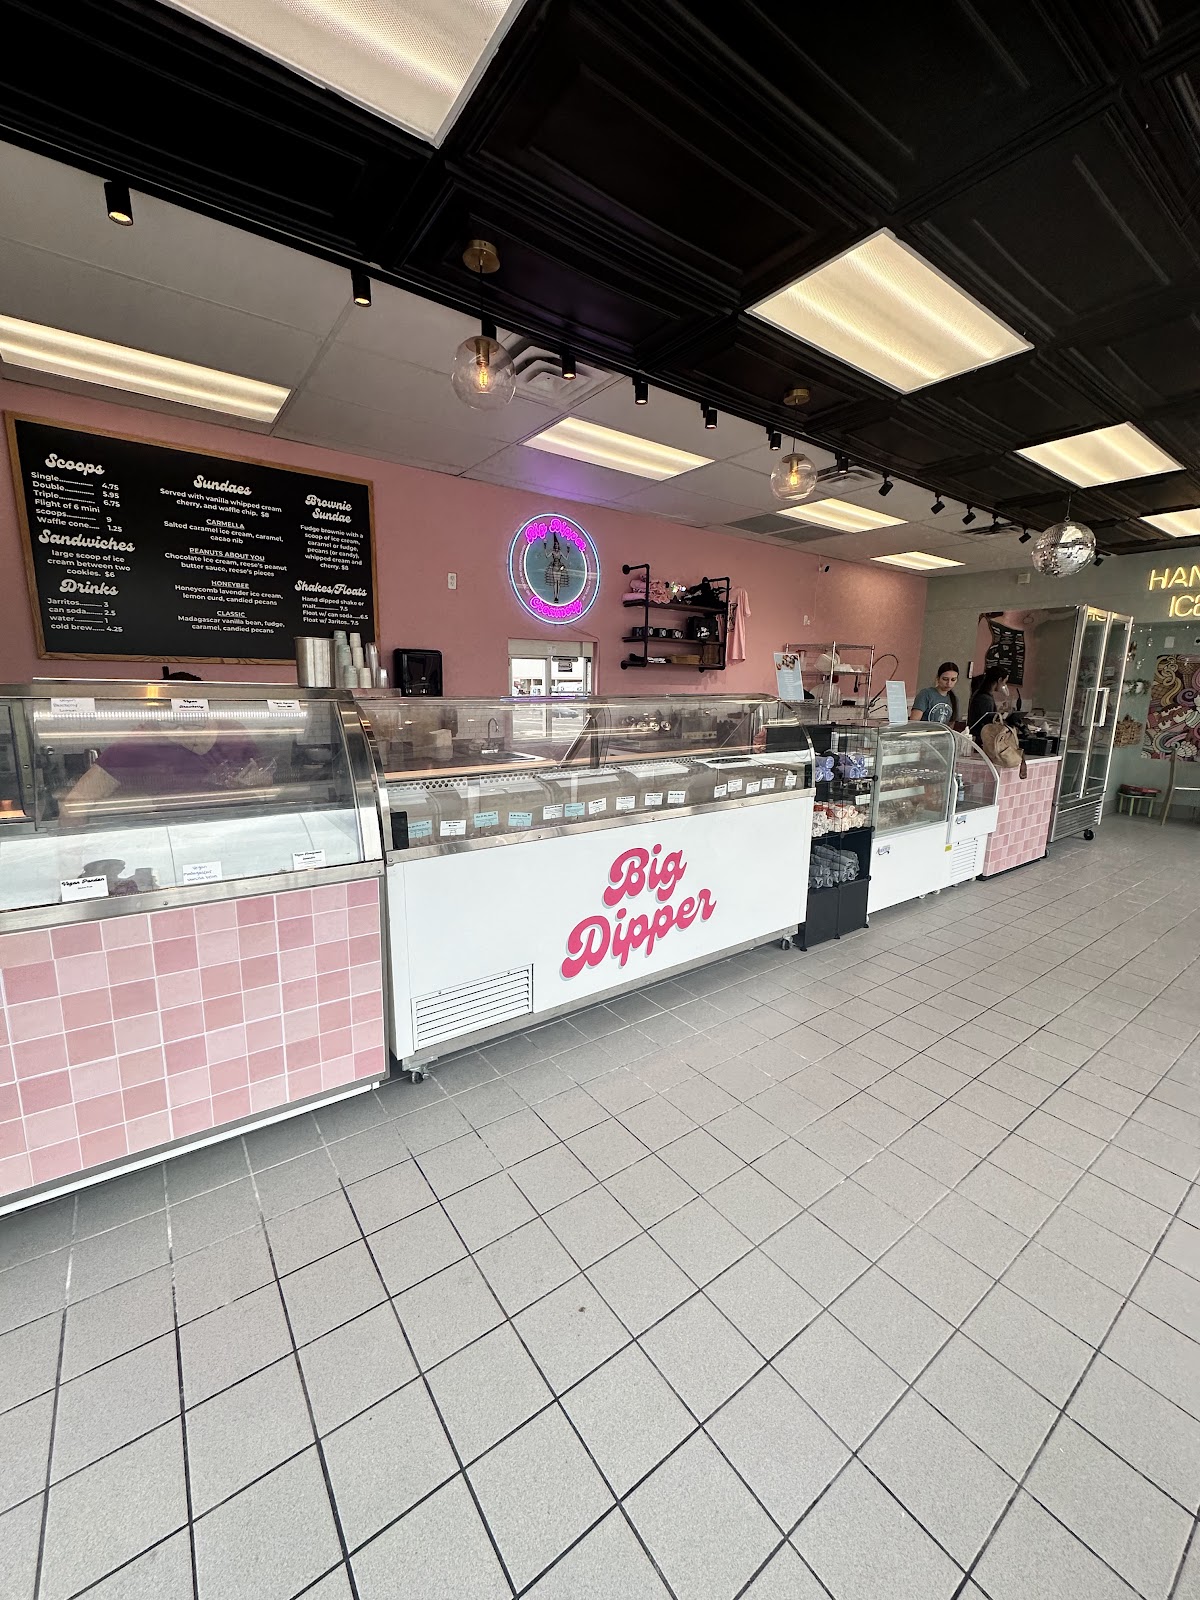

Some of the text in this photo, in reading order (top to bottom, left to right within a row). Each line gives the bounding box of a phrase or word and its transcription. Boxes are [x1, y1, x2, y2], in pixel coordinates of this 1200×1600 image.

[45, 453, 105, 476] Scoops
[102, 482, 119, 490] 4.75
[193, 474, 252, 495] Sundaes
[102, 490, 119, 498] 5.95
[160, 488, 186, 497] Served
[205, 496, 229, 504] vanilla
[230, 500, 260, 509] whipped
[34, 498, 61, 508] Flight
[81, 505, 100, 513] mini
[103, 499, 120, 507] 6.75
[176, 499, 202, 508] cherry,
[241, 508, 258, 516] chip.
[305, 494, 352, 511] Brownie
[312, 507, 351, 523] Sundae
[36, 516, 66, 525] Waffle
[107, 524, 122, 532] 1.25
[206, 518, 245, 529] CARMELLA
[300, 524, 320, 532] Fudge
[320, 527, 345, 536] brownie
[164, 520, 187, 529] Salted
[189, 525, 218, 533] caramel
[231, 530, 254, 538] cream,
[255, 534, 283, 542] caramel,
[525, 523, 547, 544] Big
[38, 529, 135, 552] Sandwiches
[51, 549, 74, 558] large
[76, 553, 101, 561] scoop
[189, 547, 265, 562] PEANUTS ABOUT YOU
[340, 544, 358, 552] fudge,
[47, 558, 75, 566] cream
[76, 560, 113, 569] between
[164, 552, 202, 561] Chocolate
[214, 558, 239, 566] cream,
[180, 561, 204, 569] butter
[320, 562, 340, 570] cherry.
[66, 568, 101, 576] cookies.
[59, 578, 119, 595] Drinks
[174, 584, 218, 593] Honeycomb
[219, 588, 249, 596] lavender
[294, 580, 367, 596] Shakes/Floats
[182, 592, 206, 600] lemon
[216, 610, 247, 618] CLASSIC
[178, 615, 220, 623] Madagascar
[264, 620, 285, 628] fudge,
[602, 843, 687, 909] Big
[560, 888, 718, 981] Dipper
